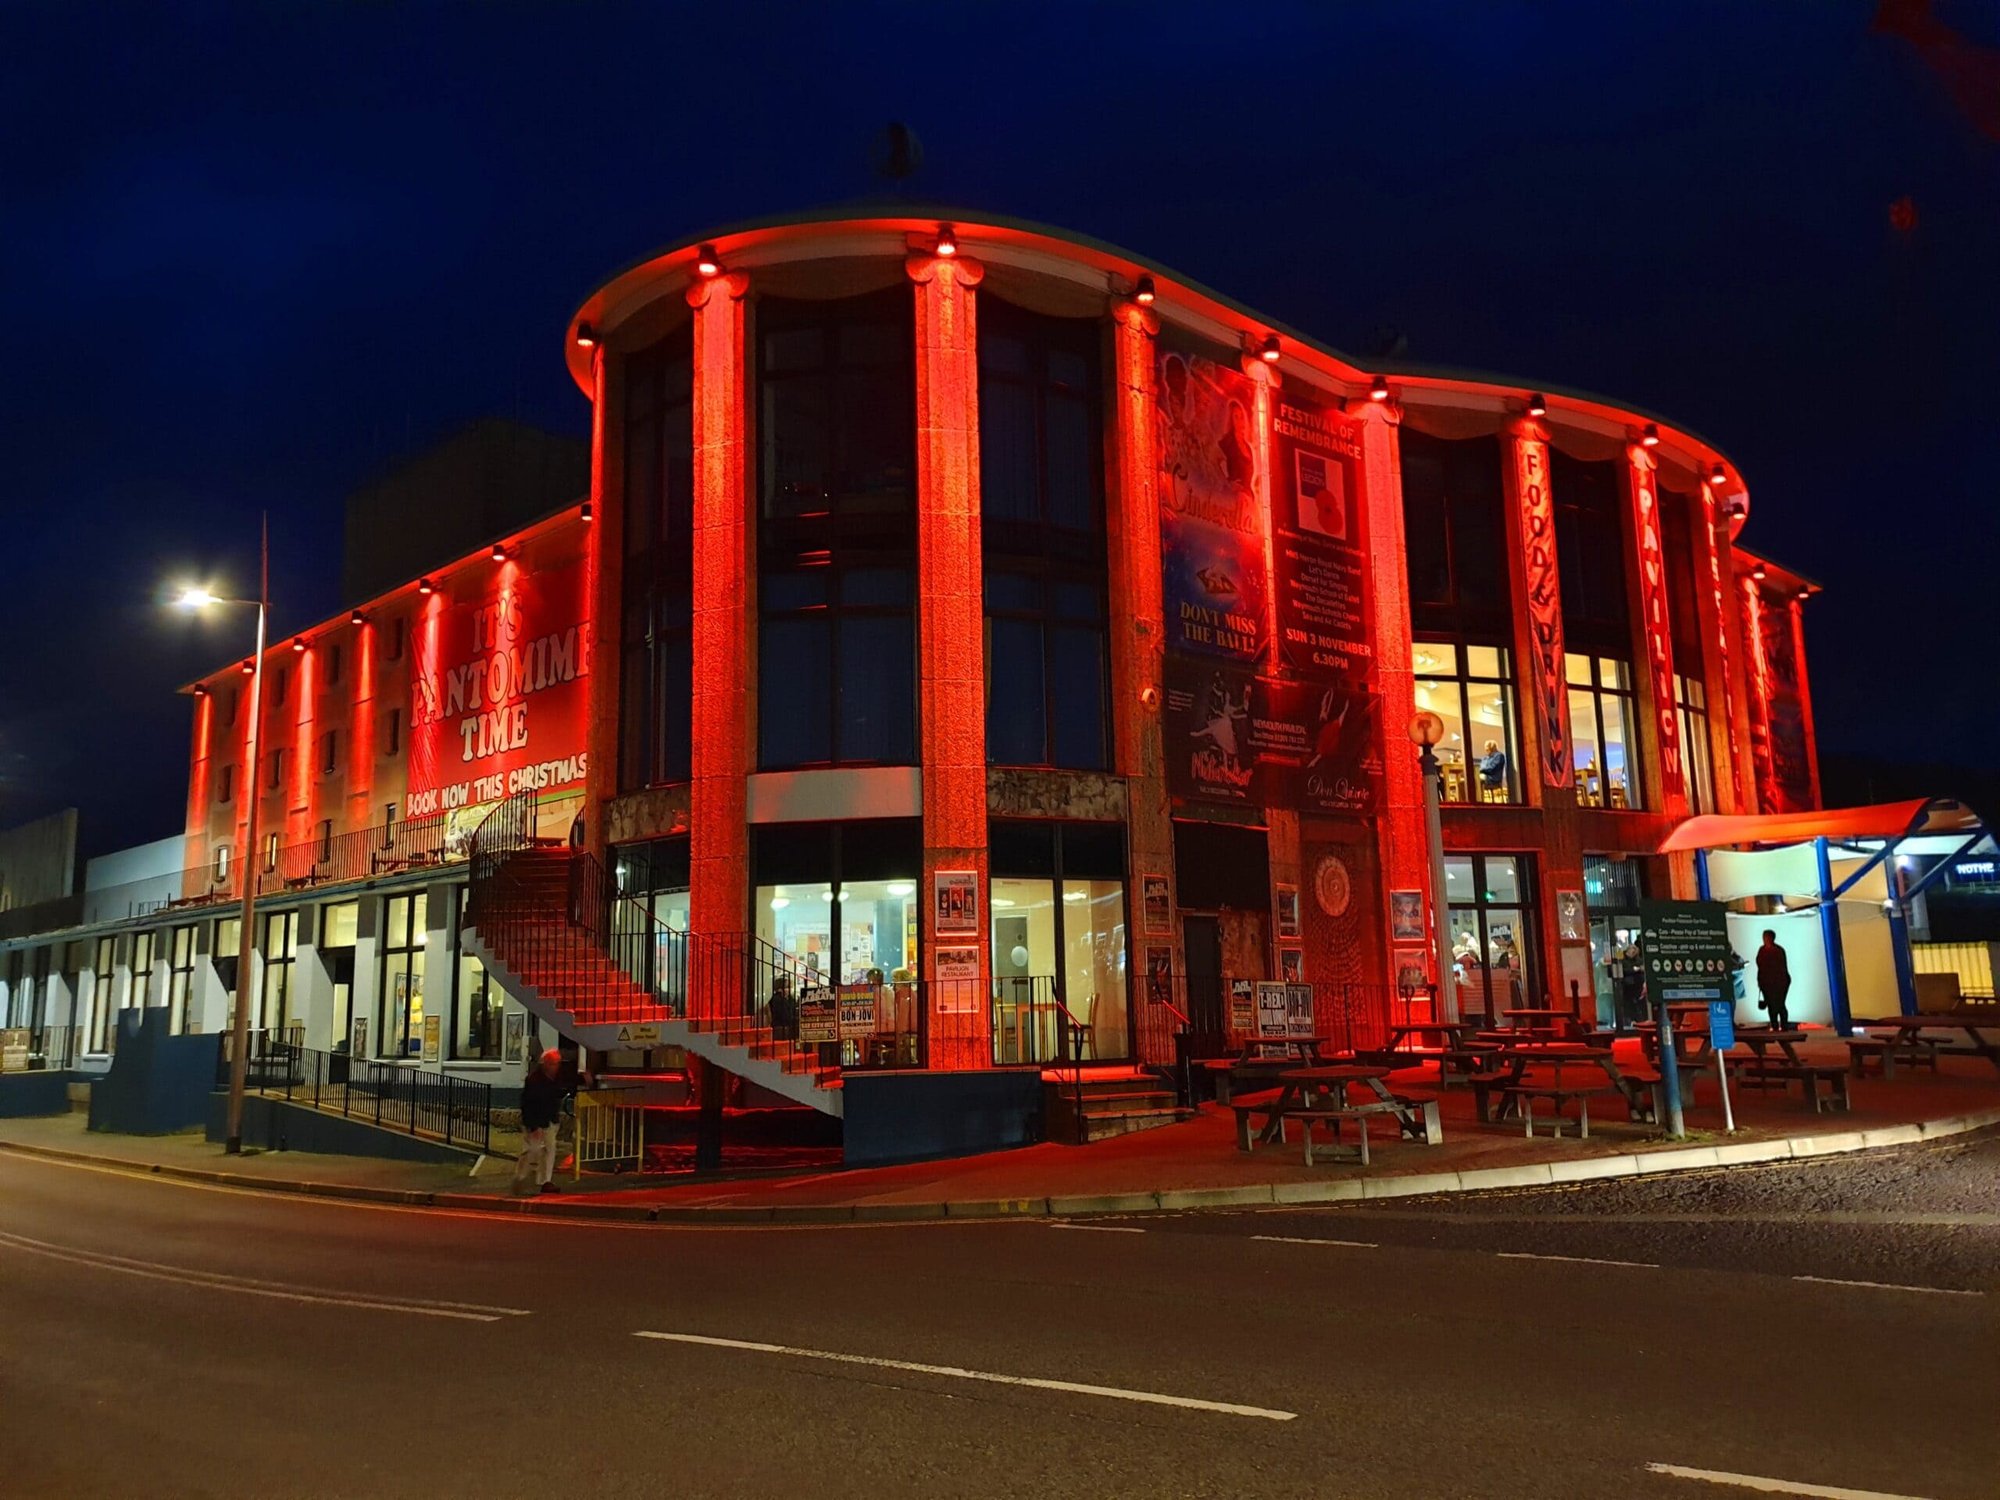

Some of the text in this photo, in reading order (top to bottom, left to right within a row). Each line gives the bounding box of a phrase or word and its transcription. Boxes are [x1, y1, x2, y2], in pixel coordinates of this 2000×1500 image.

[1274, 417, 1362, 460] REMEMBRANCE
[1280, 403, 1355, 440] FESTIVAL OF
[1172, 462, 1255, 534] Cinderella
[473, 596, 522, 654] IT'S
[1182, 621, 1256, 655] THE BALL!
[1224, 612, 1257, 636] MISS
[1526, 454, 1548, 568] FOOD
[1540, 621, 1564, 775] DRINK
[1638, 487, 1680, 775] PAVILION
[1286, 628, 1372, 657] SUN 3 NOVEMBER
[1312, 651, 1349, 670] 6.30PM
[410, 621, 590, 728] PANTOMIME
[460, 701, 528, 761] TIME
[406, 751, 587, 817] BOOK NOW THIS CHRISTMAS
[1956, 862, 1995, 875] NOTHE
